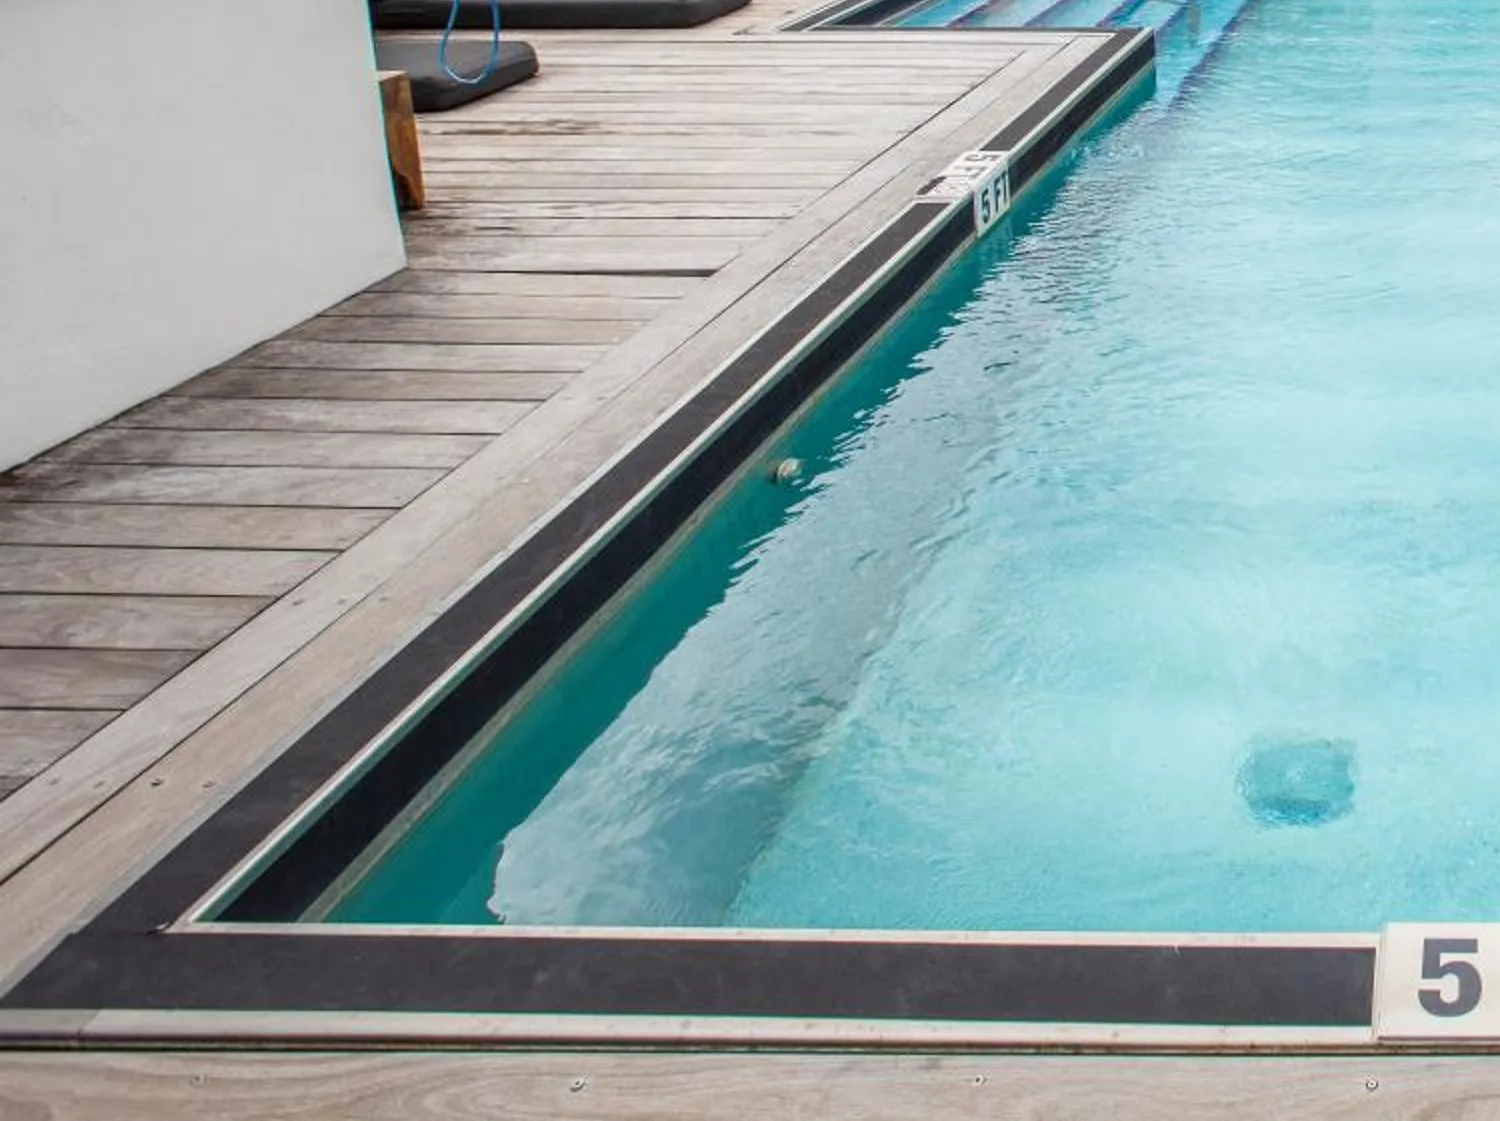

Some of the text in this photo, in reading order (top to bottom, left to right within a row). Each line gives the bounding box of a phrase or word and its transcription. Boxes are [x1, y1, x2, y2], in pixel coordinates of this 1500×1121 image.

[981, 170, 1008, 224] 5 FT
[1417, 937, 1483, 1018] 5
